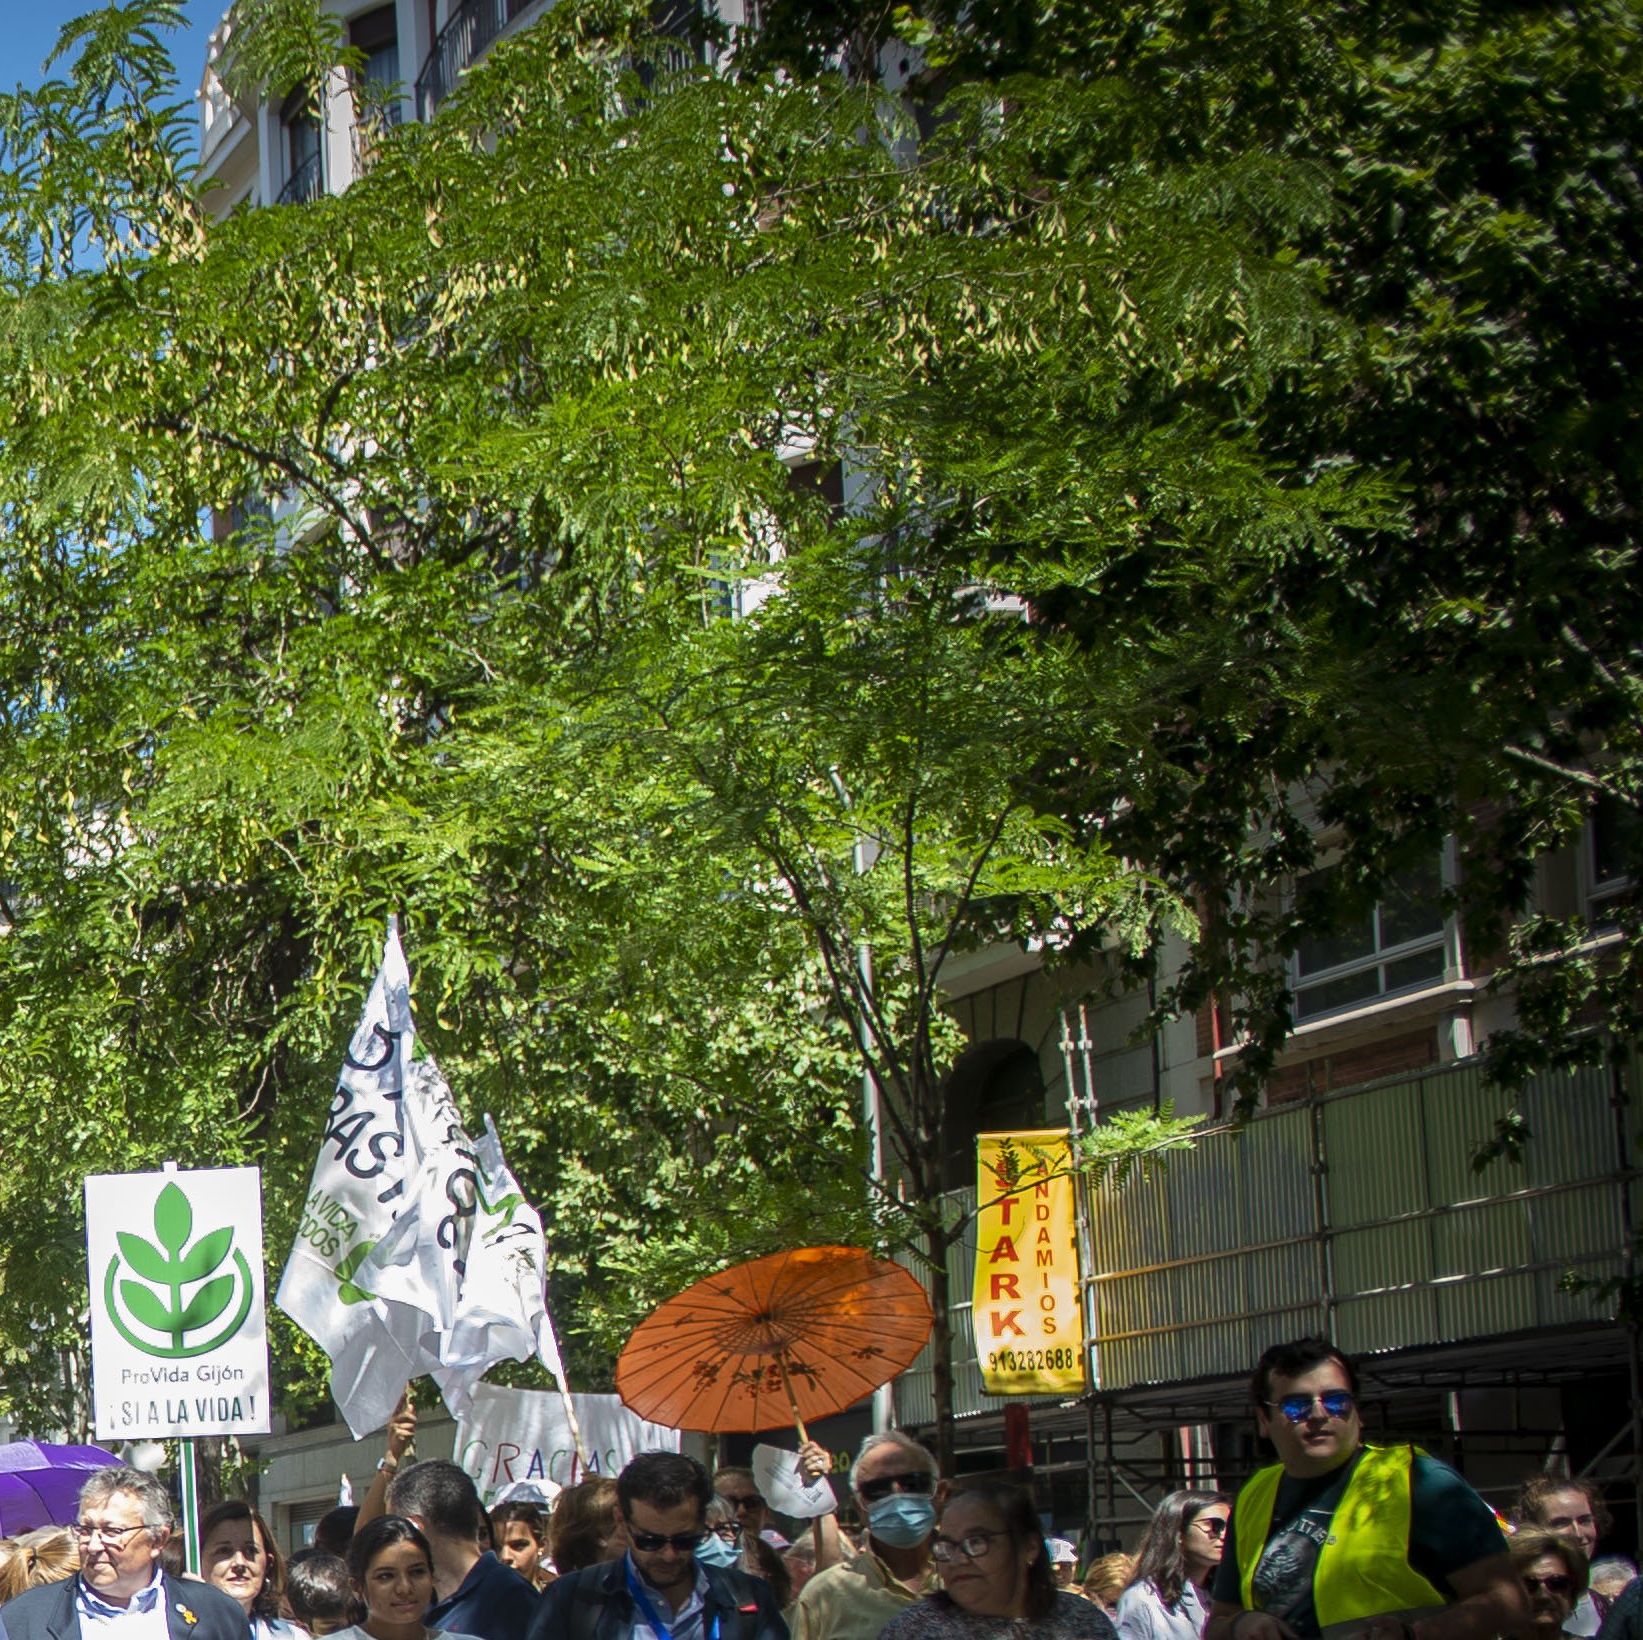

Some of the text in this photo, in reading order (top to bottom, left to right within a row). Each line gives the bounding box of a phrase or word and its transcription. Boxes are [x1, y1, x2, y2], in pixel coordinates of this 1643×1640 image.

[988, 1158, 1026, 1337] STARK
[1035, 1158, 1057, 1335] ANDAMIOS
[122, 1366, 244, 1385] ProVida Gijón
[989, 1348, 1073, 1372] 913282688
[148, 1401, 159, 1425] A
[166, 1398, 190, 1424] LA
[461, 1440, 617, 1488] GRACIAS
